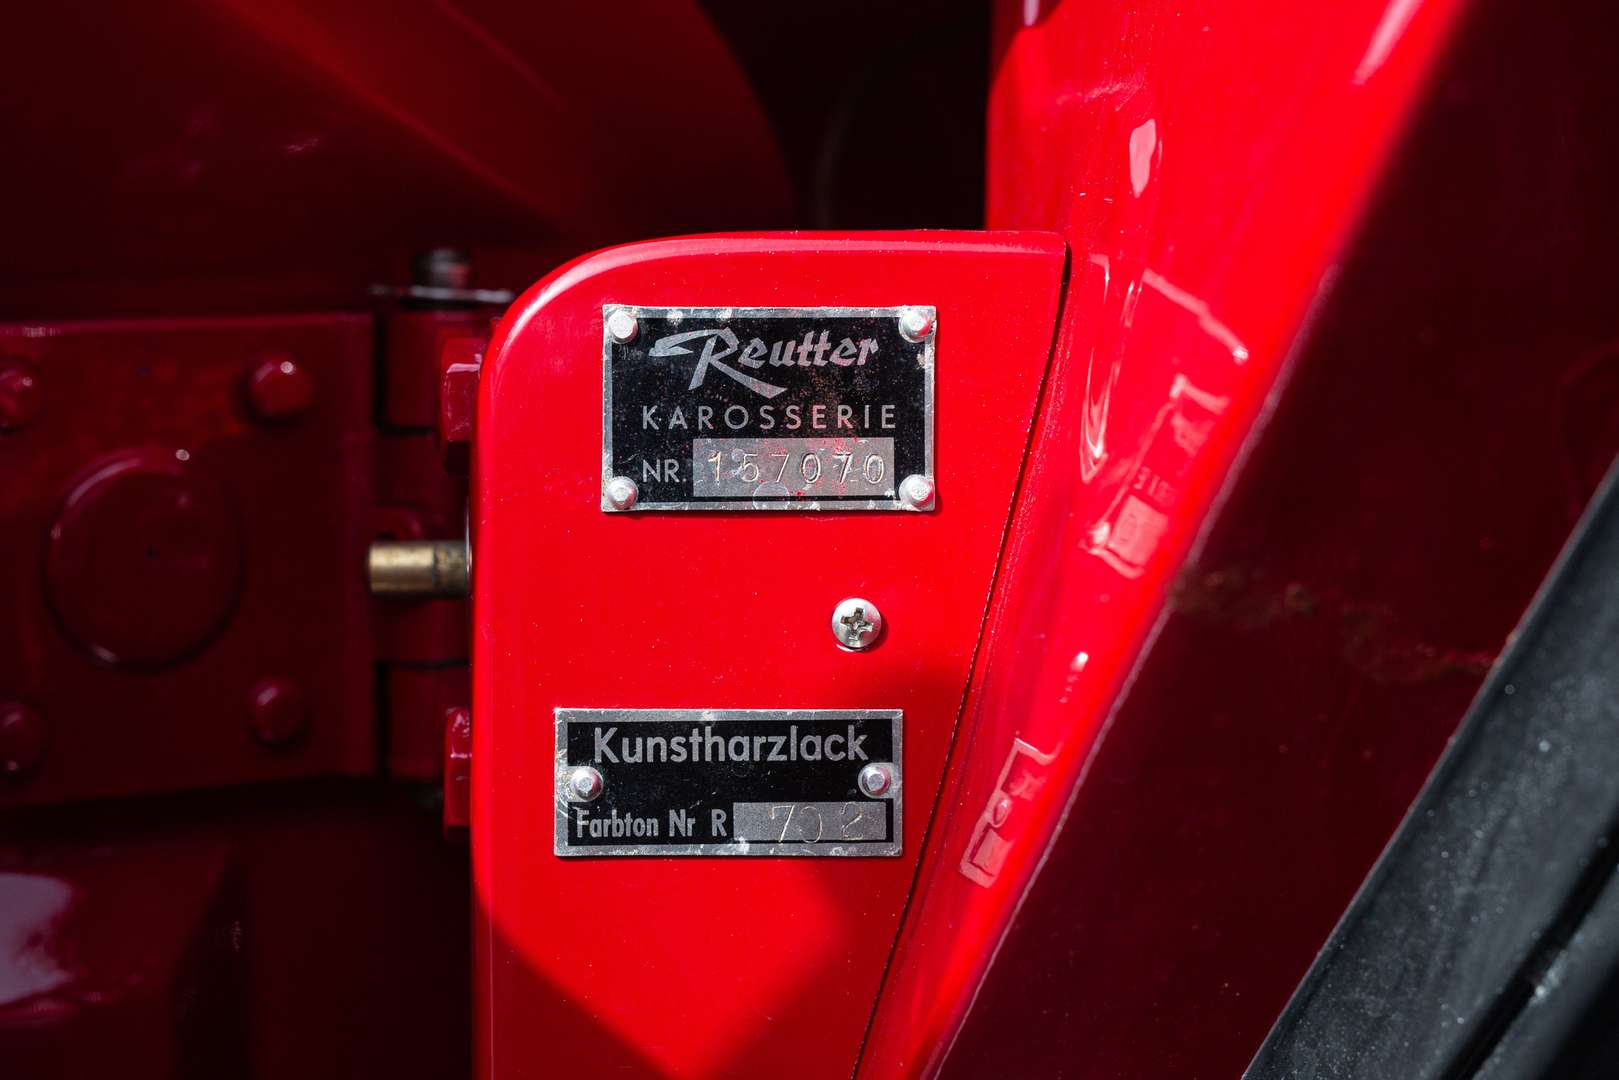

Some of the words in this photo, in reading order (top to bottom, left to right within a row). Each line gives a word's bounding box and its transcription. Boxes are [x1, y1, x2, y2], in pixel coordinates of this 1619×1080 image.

[648, 326, 879, 399] Reutter
[642, 404, 896, 430] KAROSSERIE
[642, 459, 687, 483] NR.
[706, 453, 885, 485] 157070
[593, 724, 869, 764] Kunstharzlack
[575, 808, 659, 838] Farbton
[668, 808, 696, 837] Nr
[711, 808, 727, 837] R
